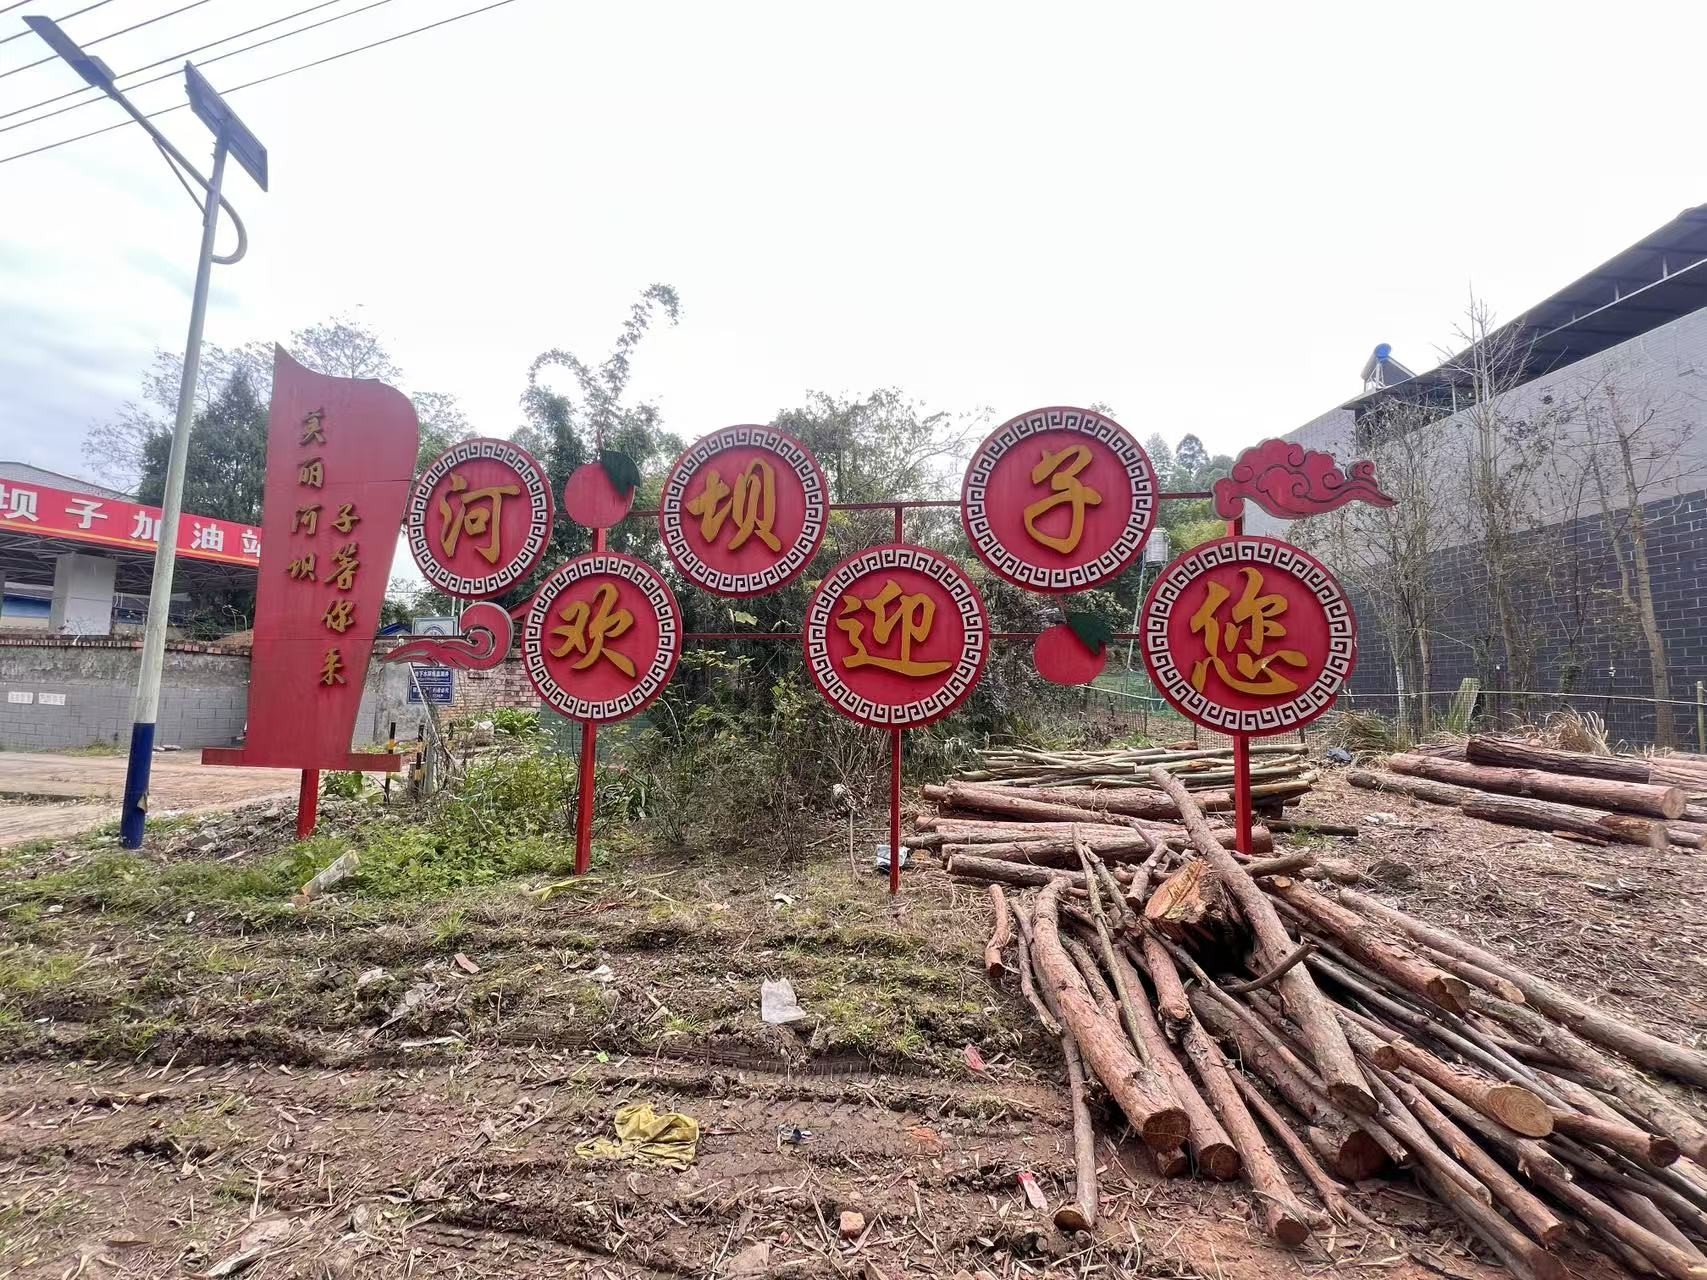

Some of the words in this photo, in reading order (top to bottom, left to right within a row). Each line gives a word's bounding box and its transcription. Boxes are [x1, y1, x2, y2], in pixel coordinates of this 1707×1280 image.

[440, 444, 1101, 563] 河坝子
[549, 567, 1308, 695] 欢迎您
